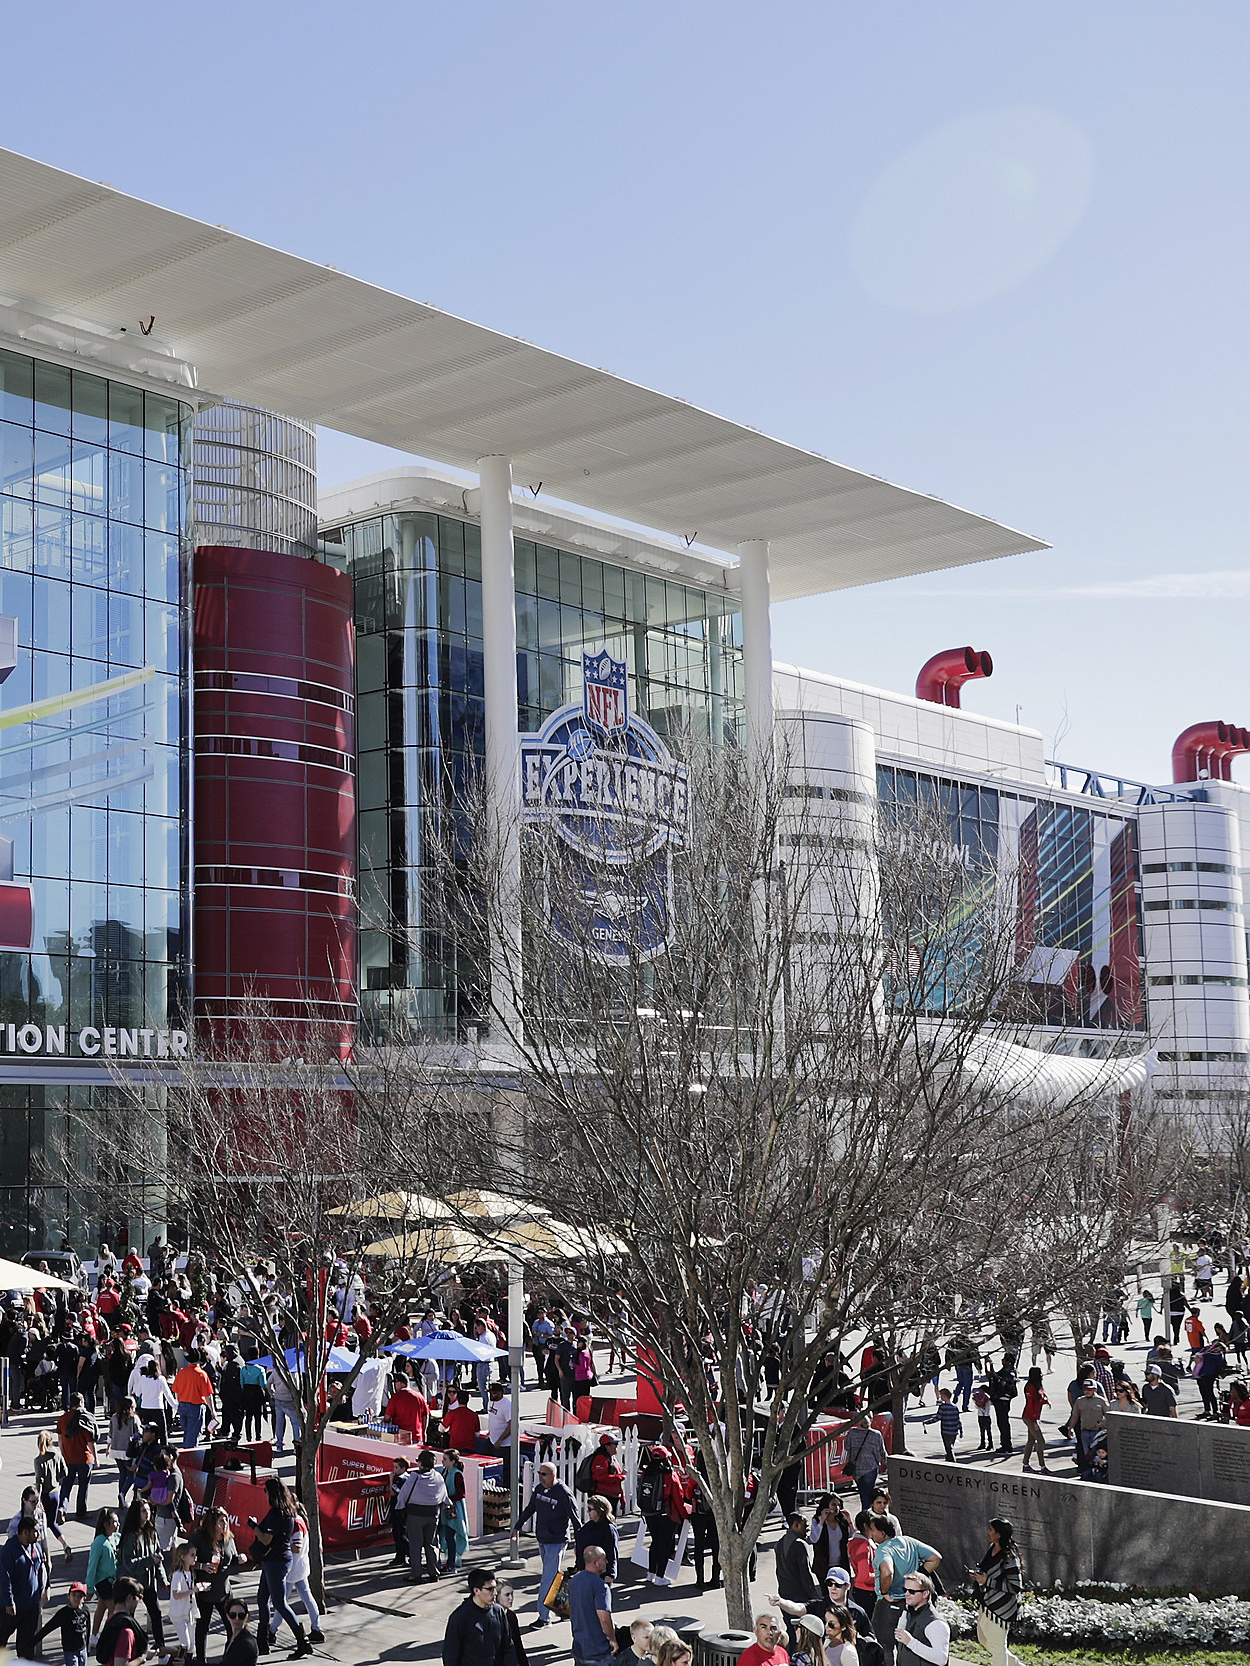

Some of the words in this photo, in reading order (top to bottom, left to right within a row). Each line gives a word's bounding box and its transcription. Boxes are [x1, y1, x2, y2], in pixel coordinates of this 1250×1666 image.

[587, 684, 623, 728] NFL
[525, 754, 688, 825] EXPERIENCE
[77, 1026, 188, 1057] CENTER
[341, 1459, 365, 1469] SUPER
[366, 1464, 384, 1473] BOWL
[360, 1485, 385, 1496] SUPER
[899, 1467, 982, 1489] DISCOVERY
[990, 1482, 1041, 1499] GREEN
[347, 1495, 391, 1532] LIV
